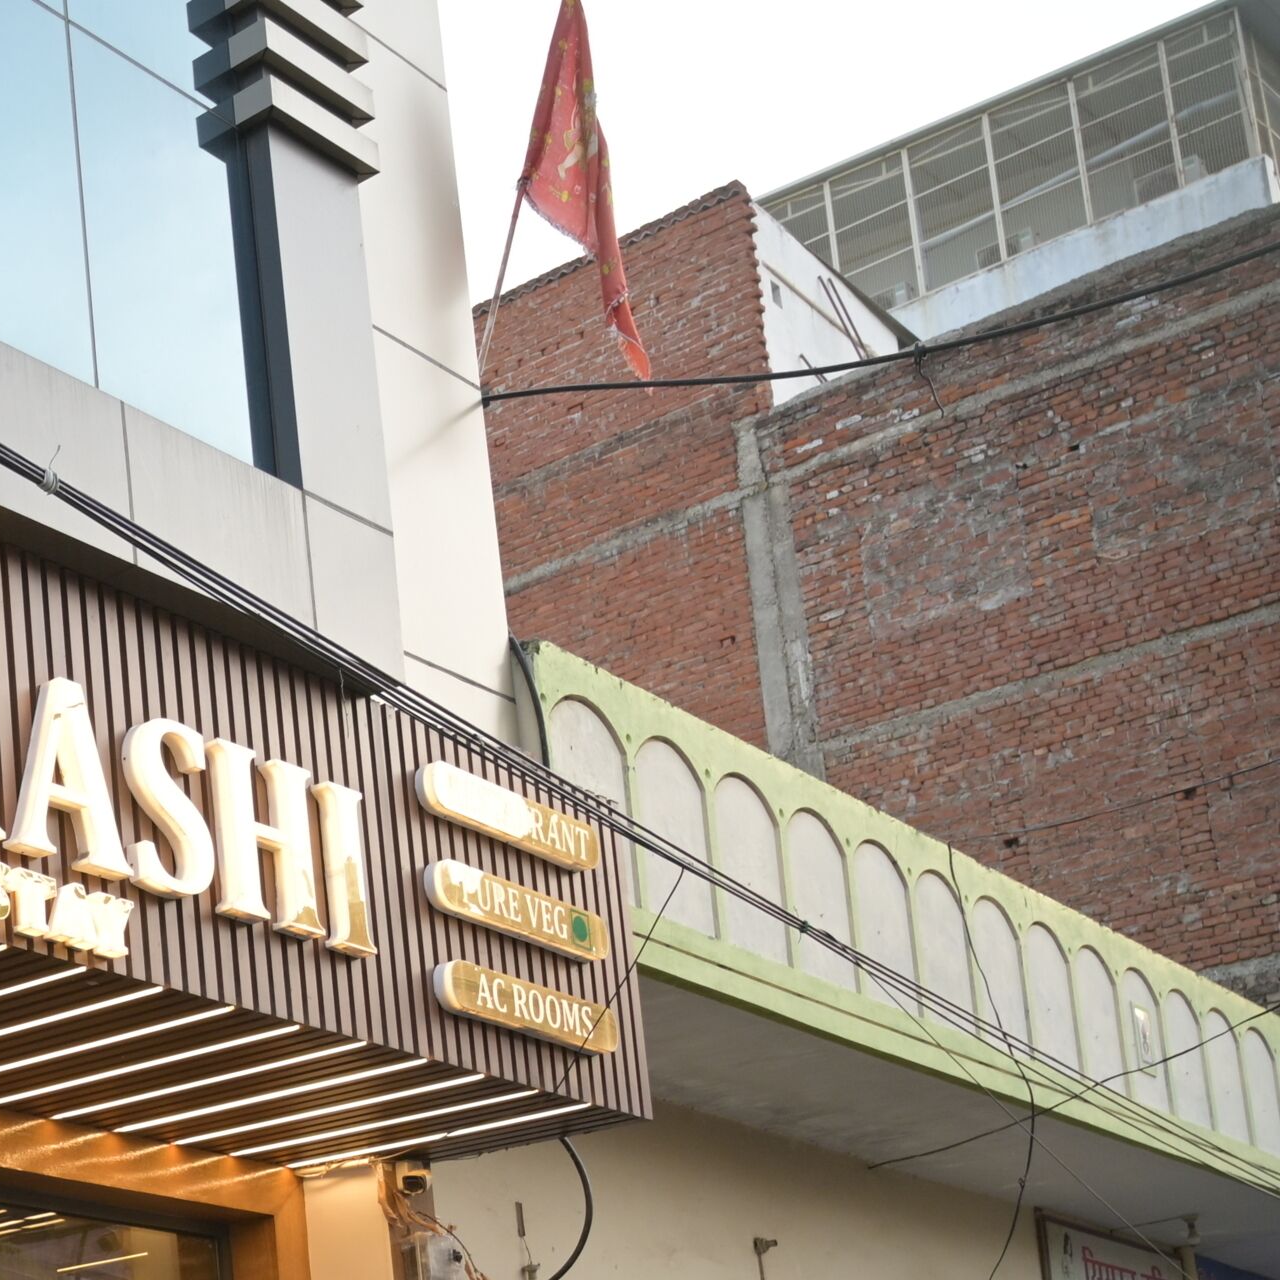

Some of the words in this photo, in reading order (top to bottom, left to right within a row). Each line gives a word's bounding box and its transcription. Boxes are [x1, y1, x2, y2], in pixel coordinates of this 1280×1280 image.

[461, 876, 520, 923] PURE
[525, 896, 569, 941] VEG
[476, 973, 509, 1014] AC
[513, 984, 594, 1039] ROOMS
